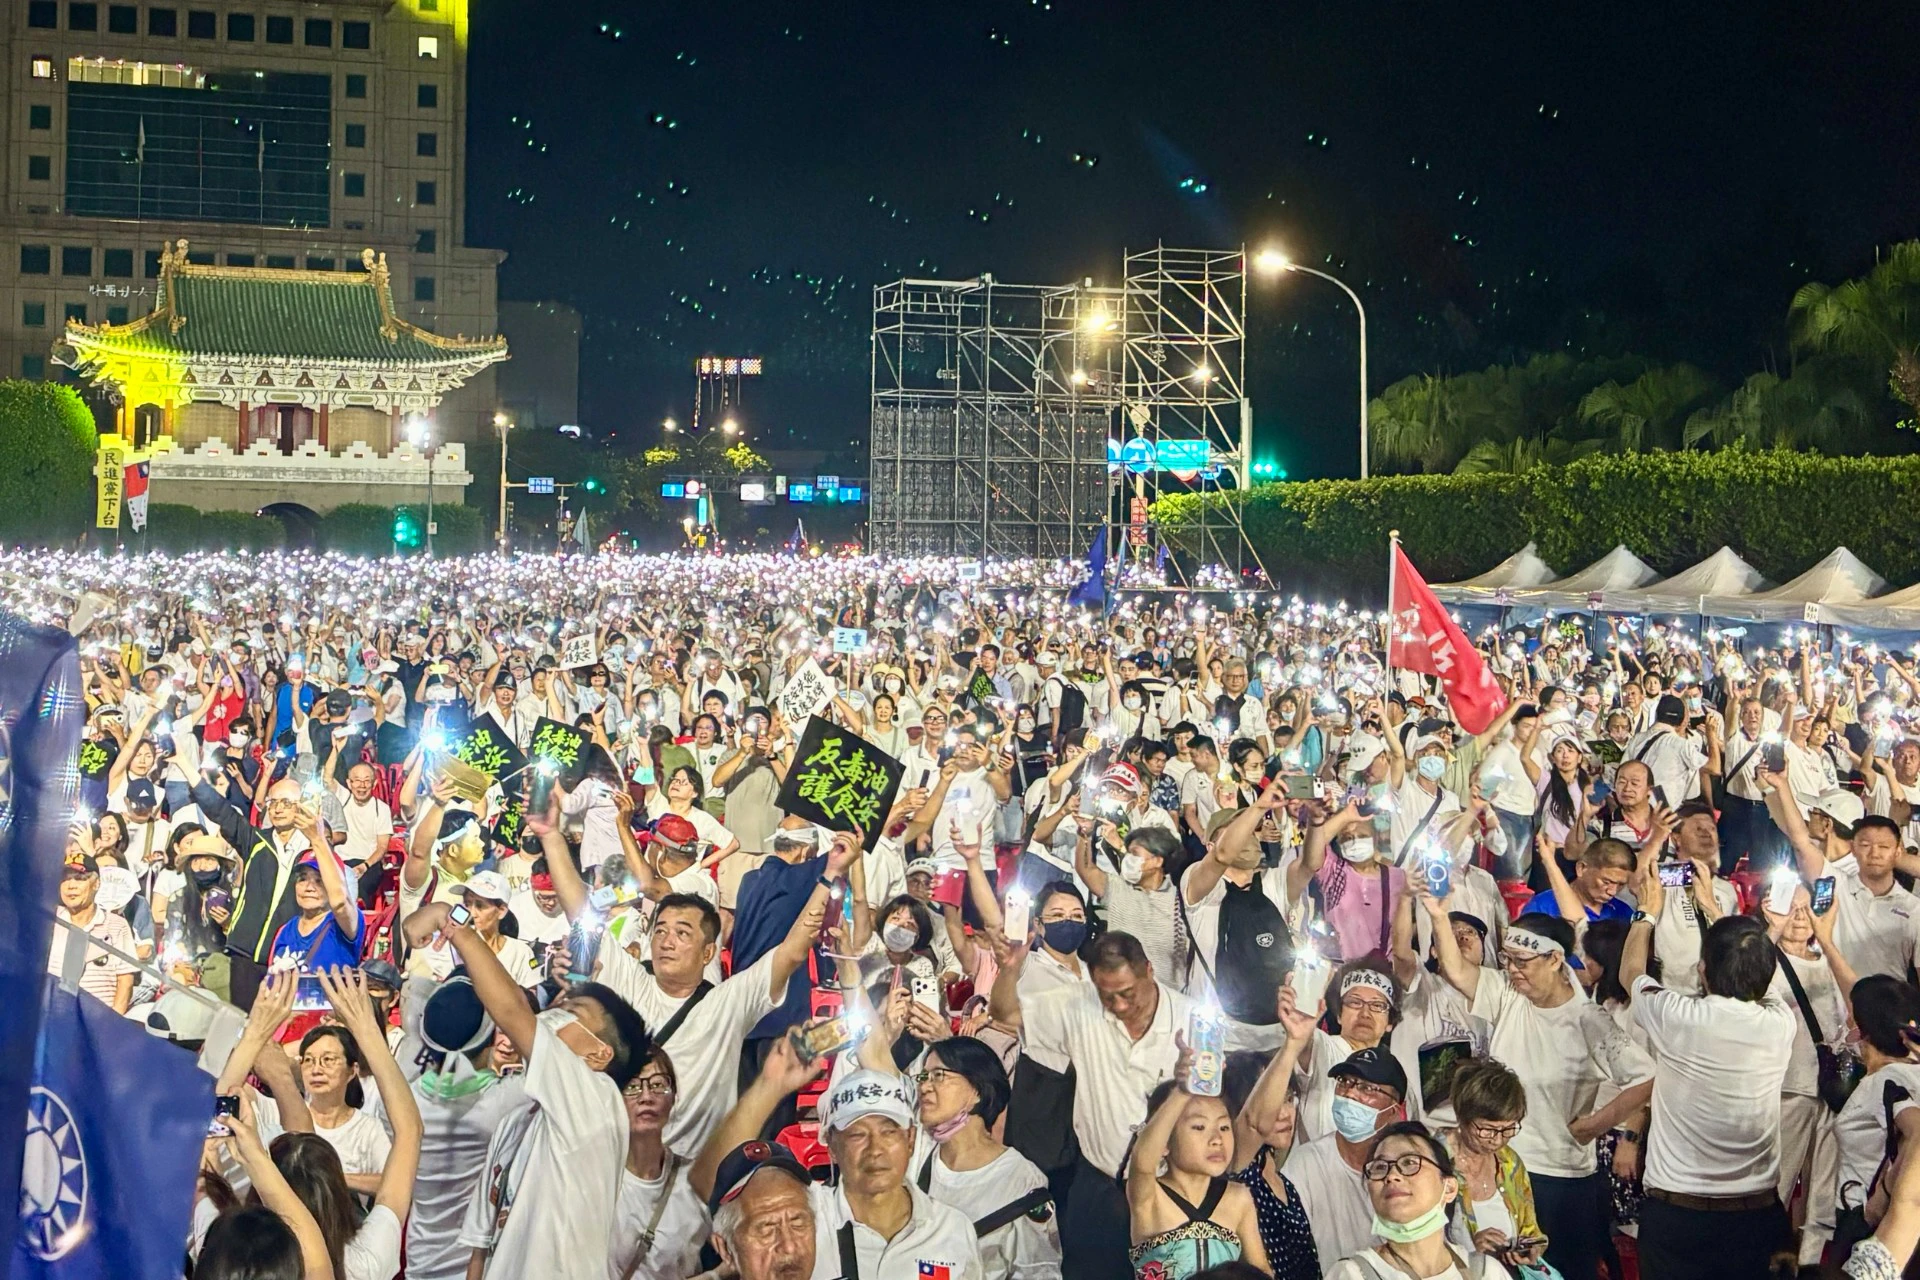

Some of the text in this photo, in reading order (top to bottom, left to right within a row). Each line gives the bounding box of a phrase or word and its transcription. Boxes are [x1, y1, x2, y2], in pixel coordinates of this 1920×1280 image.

[103, 452, 119, 526] 民進黨下台
[535, 724, 583, 750] 反毒油
[804, 737, 889, 796] 反毒油
[796, 767, 881, 833] 護食安
